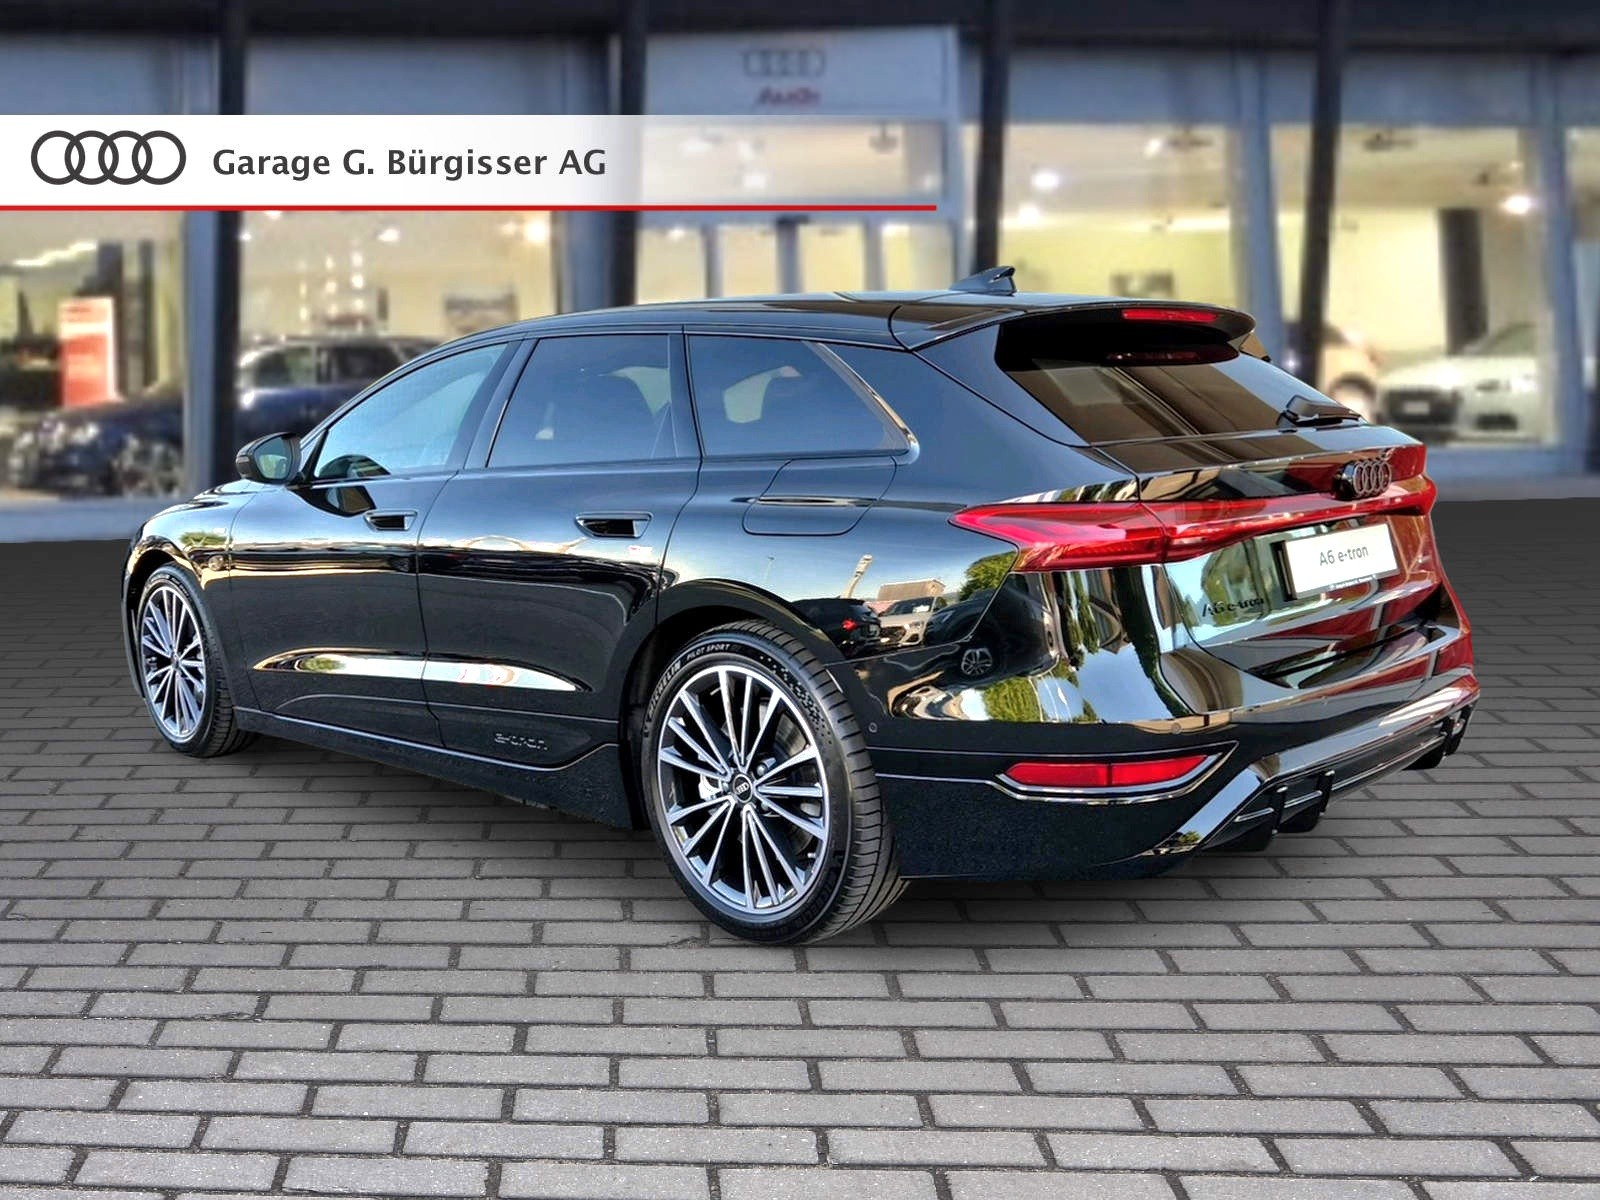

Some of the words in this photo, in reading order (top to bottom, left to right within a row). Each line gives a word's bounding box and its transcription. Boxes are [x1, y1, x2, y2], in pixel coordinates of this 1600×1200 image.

[1319, 549, 1335, 566] A6
[1337, 546, 1369, 562] e-tron
[686, 647, 705, 661] PILOT
[706, 643, 731, 653] SPORT
